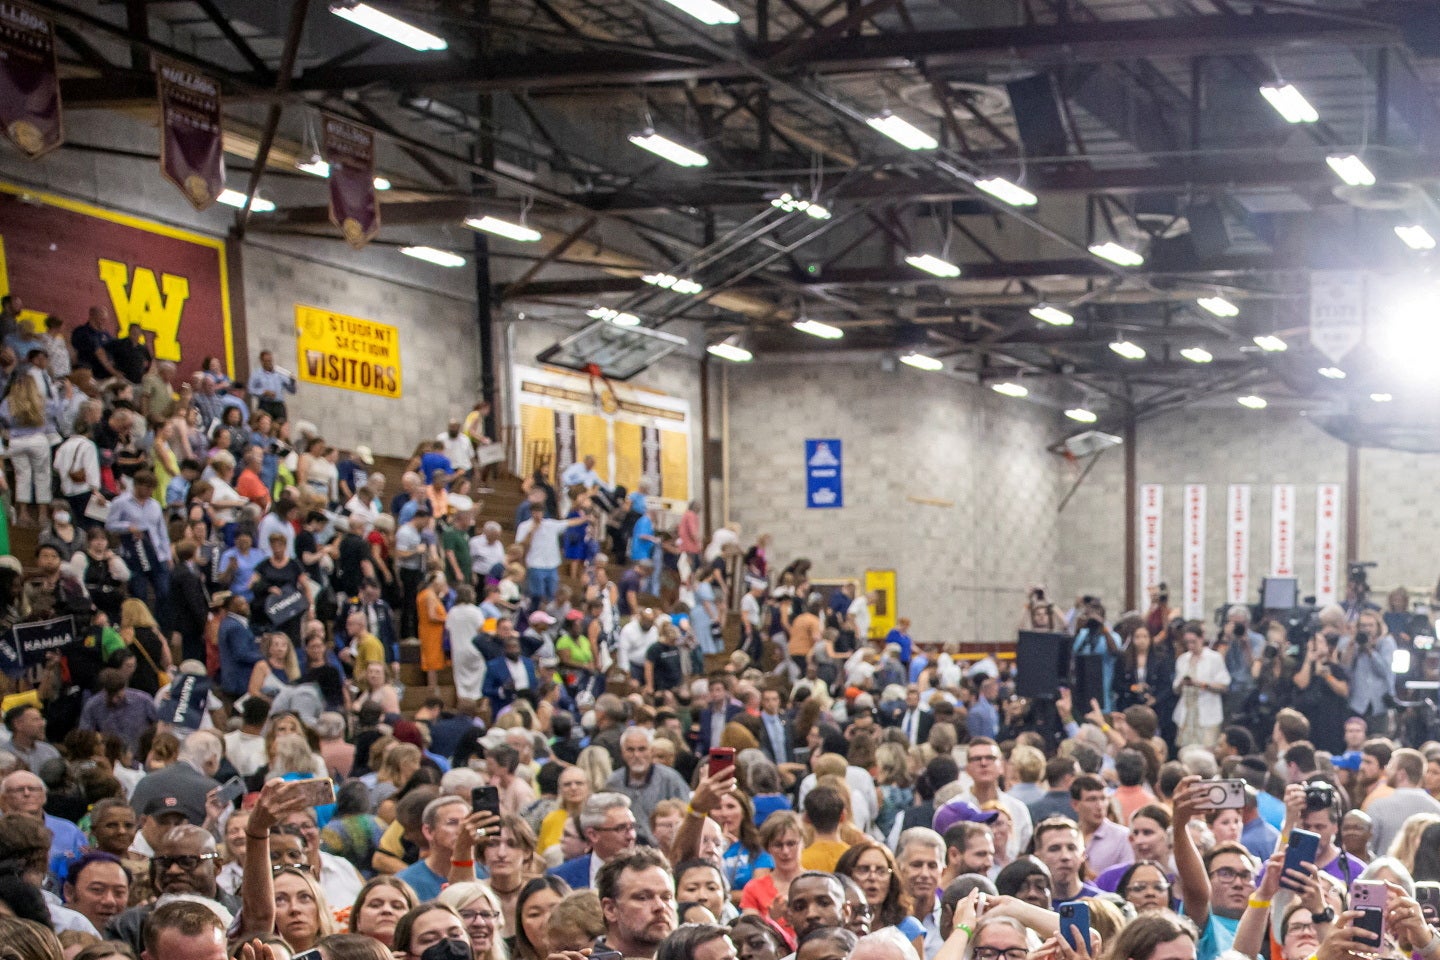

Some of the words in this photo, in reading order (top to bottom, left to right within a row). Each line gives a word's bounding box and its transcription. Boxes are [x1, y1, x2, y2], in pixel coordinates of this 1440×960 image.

[328, 315, 391, 343] STUDENT
[335, 335, 389, 359] SECTION
[305, 349, 397, 393] VISITORS
[24, 632, 73, 652] KAMALA
